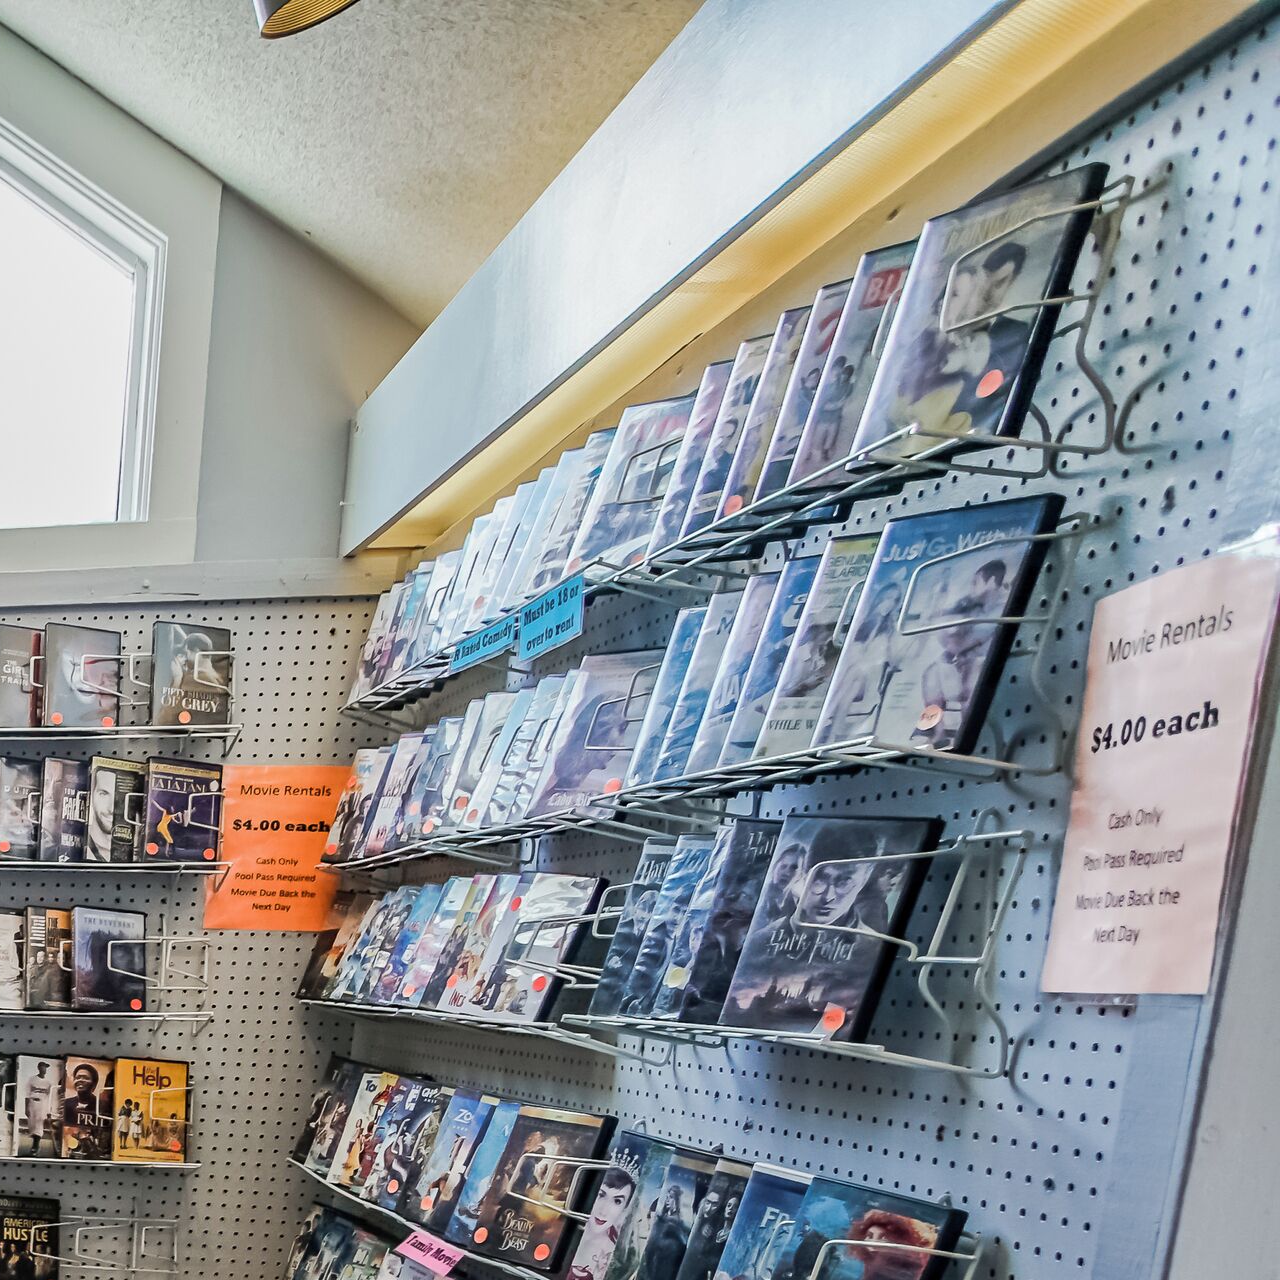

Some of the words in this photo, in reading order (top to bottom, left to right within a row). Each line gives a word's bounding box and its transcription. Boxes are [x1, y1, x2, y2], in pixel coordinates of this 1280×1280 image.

[881, 540, 924, 564] Just
[523, 604, 545, 627] Must
[545, 597, 556, 618] be
[557, 590, 570, 608] 18
[570, 585, 580, 600] or
[482, 623, 514, 651] Comedy
[526, 633, 544, 652] over
[544, 626, 554, 643] to
[555, 615, 575, 638] rent
[1106, 629, 1154, 665] Movie
[1161, 605, 1234, 651] Rentals
[162, 687, 185, 698] FIFTY
[161, 696, 180, 708] OF
[181, 697, 219, 713] GREY
[1091, 715, 1147, 754] $4.00
[1151, 701, 1219, 739] each
[240, 785, 280, 796] Movie
[284, 785, 332, 797] Rentals
[232, 819, 280, 832] $4.00
[285, 820, 331, 833] each
[1108, 811, 1132, 831] Cash
[1135, 806, 1163, 828] Only
[256, 857, 276, 865] Cash
[278, 858, 299, 867] Only
[1103, 852, 1126, 868] Pass
[1129, 845, 1184, 868] Required
[235, 872, 254, 880] Pool
[256, 873, 275, 881] Pass
[277, 873, 316, 883] Required
[231, 888, 257, 896] Movie
[259, 889, 276, 897] Due
[279, 889, 298, 898] Back
[301, 890, 316, 898] the
[1075, 893, 1103, 911] Movie
[1105, 892, 1125, 908] Due
[1128, 889, 1155, 906] Back
[1158, 887, 1181, 905] the
[274, 903, 291, 912] Day
[84, 917, 97, 925] THE
[99, 918, 136, 928] REVENANT
[765, 929, 806, 961] Harry
[808, 930, 857, 965] Potter
[1093, 927, 1116, 943] Next
[1118, 926, 1140, 947] Day
[133, 1065, 171, 1090] Help
[504, 1210, 535, 1233] BEAUTY
[3, 1228, 49, 1243] HUSTLE
[406, 1234, 434, 1258] Family
[500, 1231, 531, 1251] BEAST
